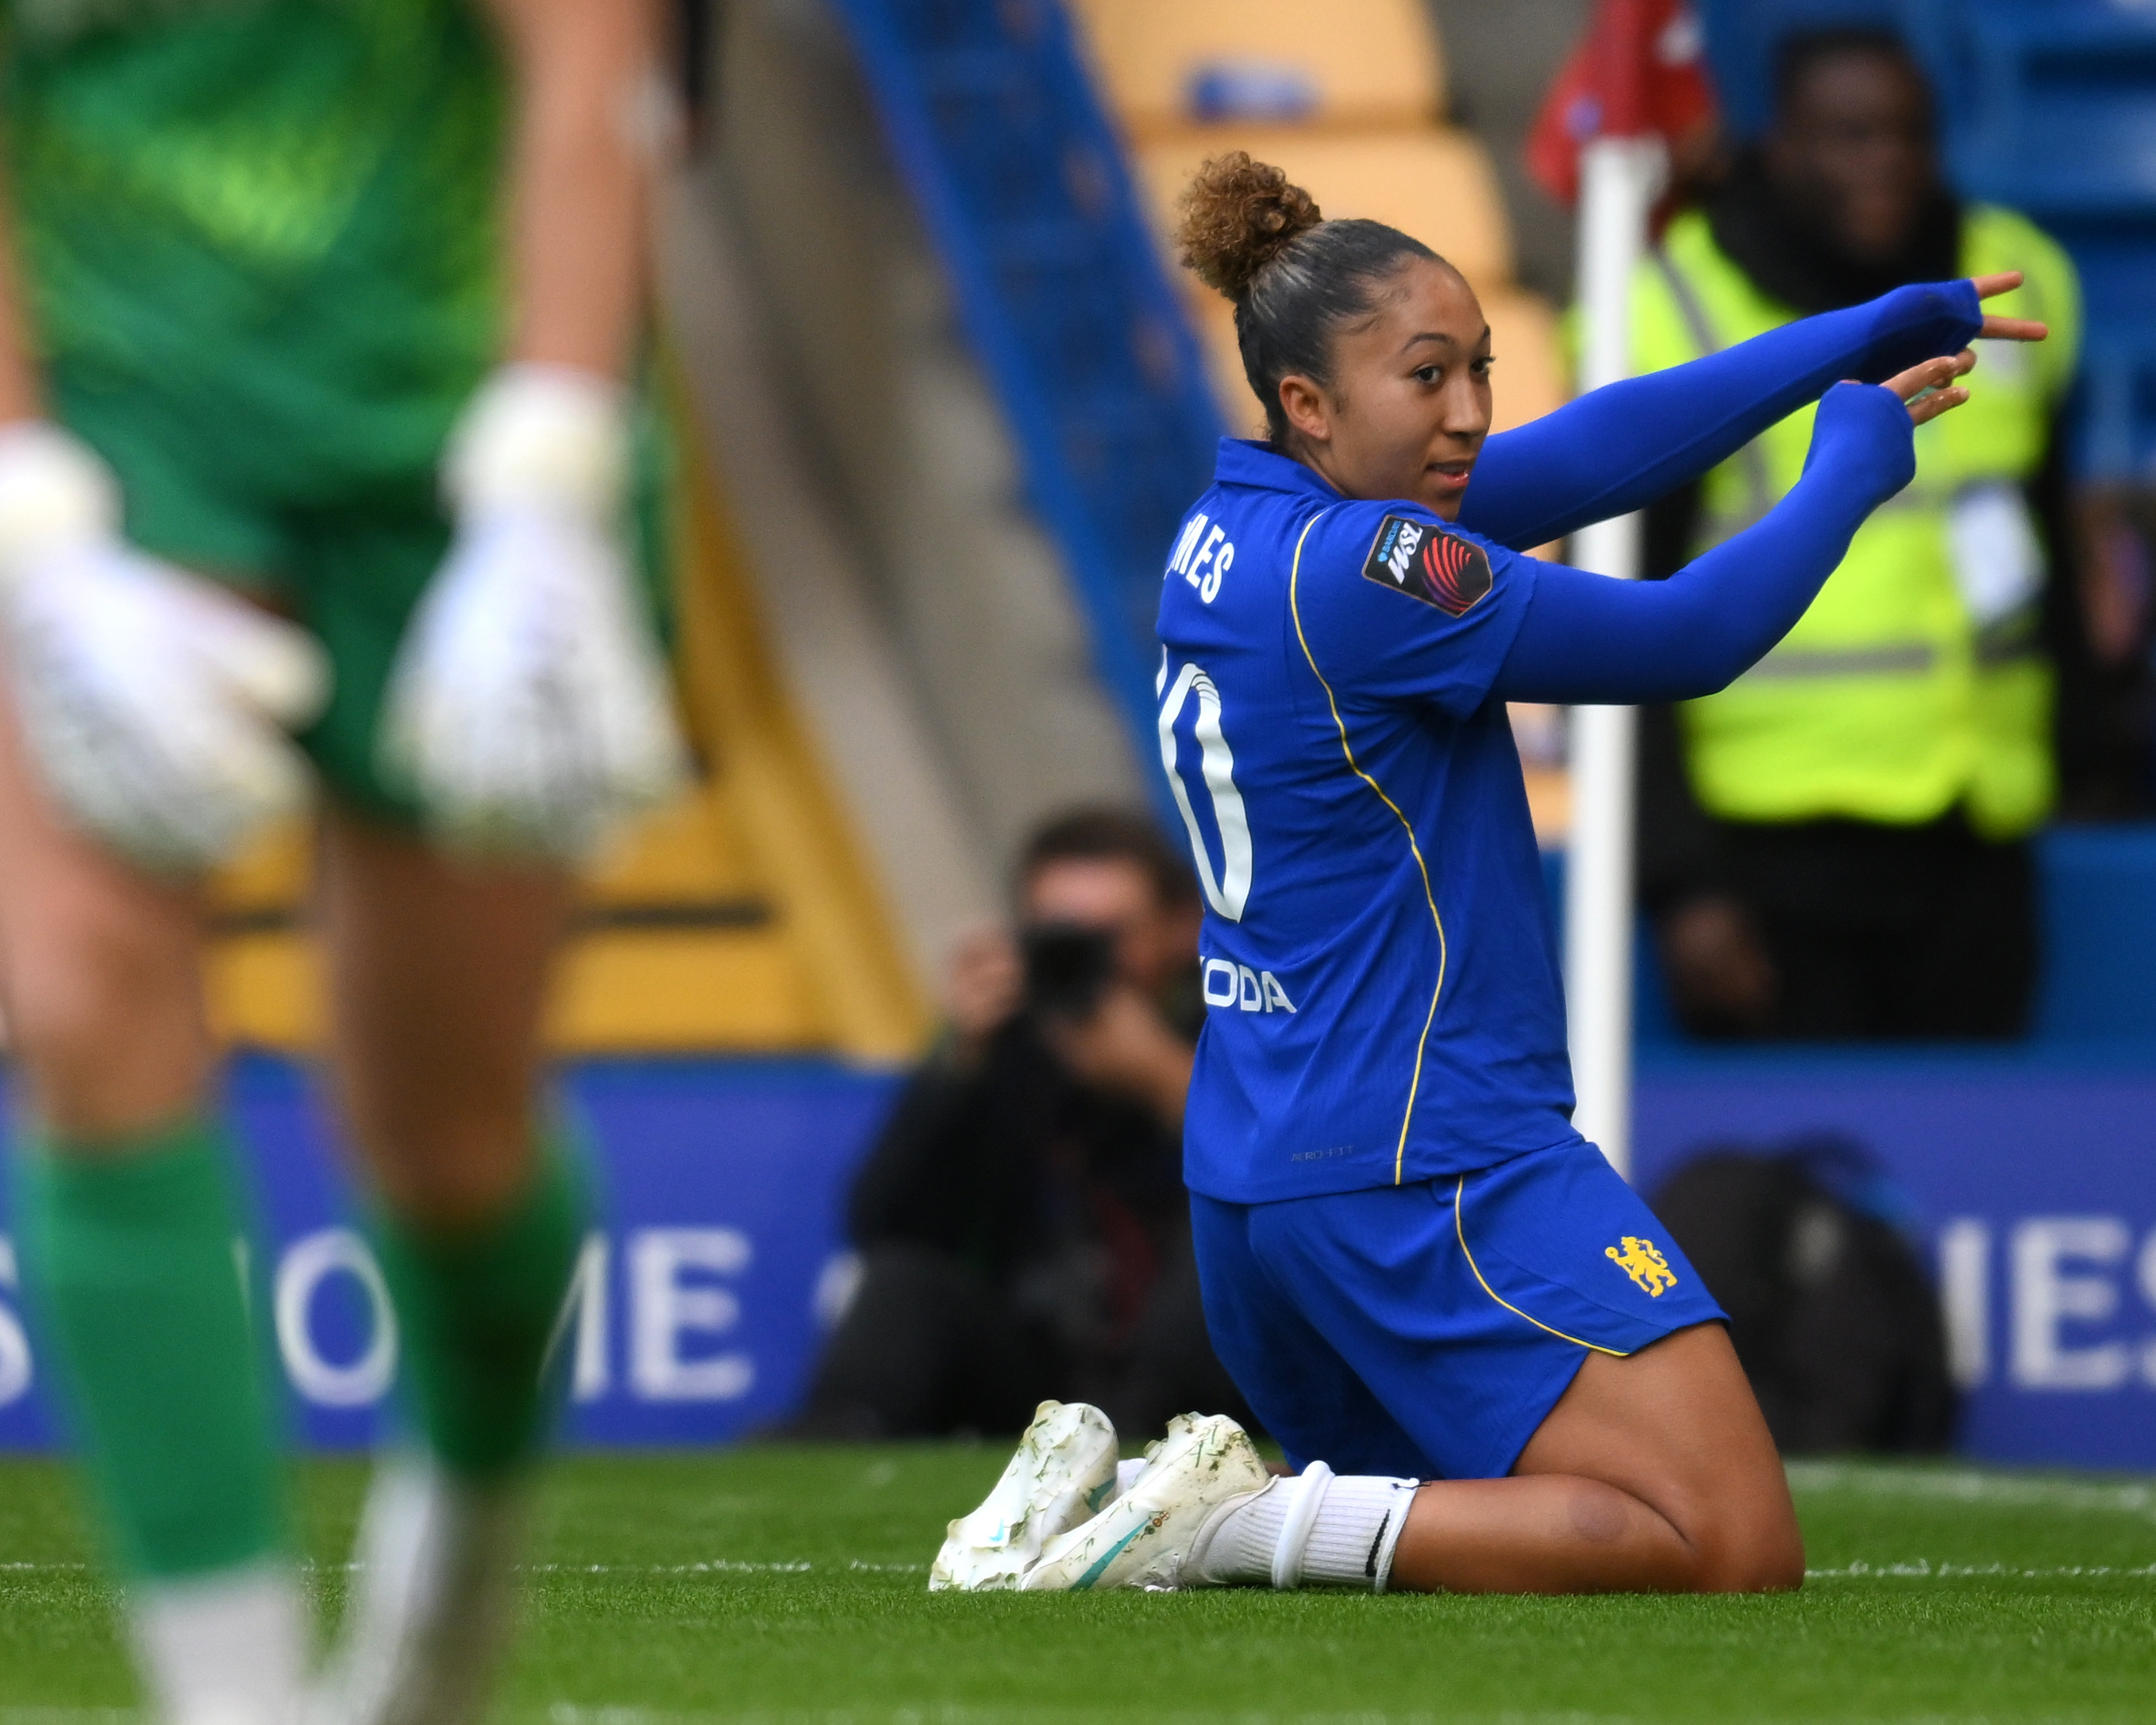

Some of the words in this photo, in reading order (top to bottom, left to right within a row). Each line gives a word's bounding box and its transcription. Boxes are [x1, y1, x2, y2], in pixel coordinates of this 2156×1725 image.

[1164, 513, 1235, 604] MES
[1388, 522, 1423, 585] WSL
[1156, 644, 1253, 924] 0
[1199, 955, 1298, 1014] ODA
[232, 1226, 755, 1407] OME
